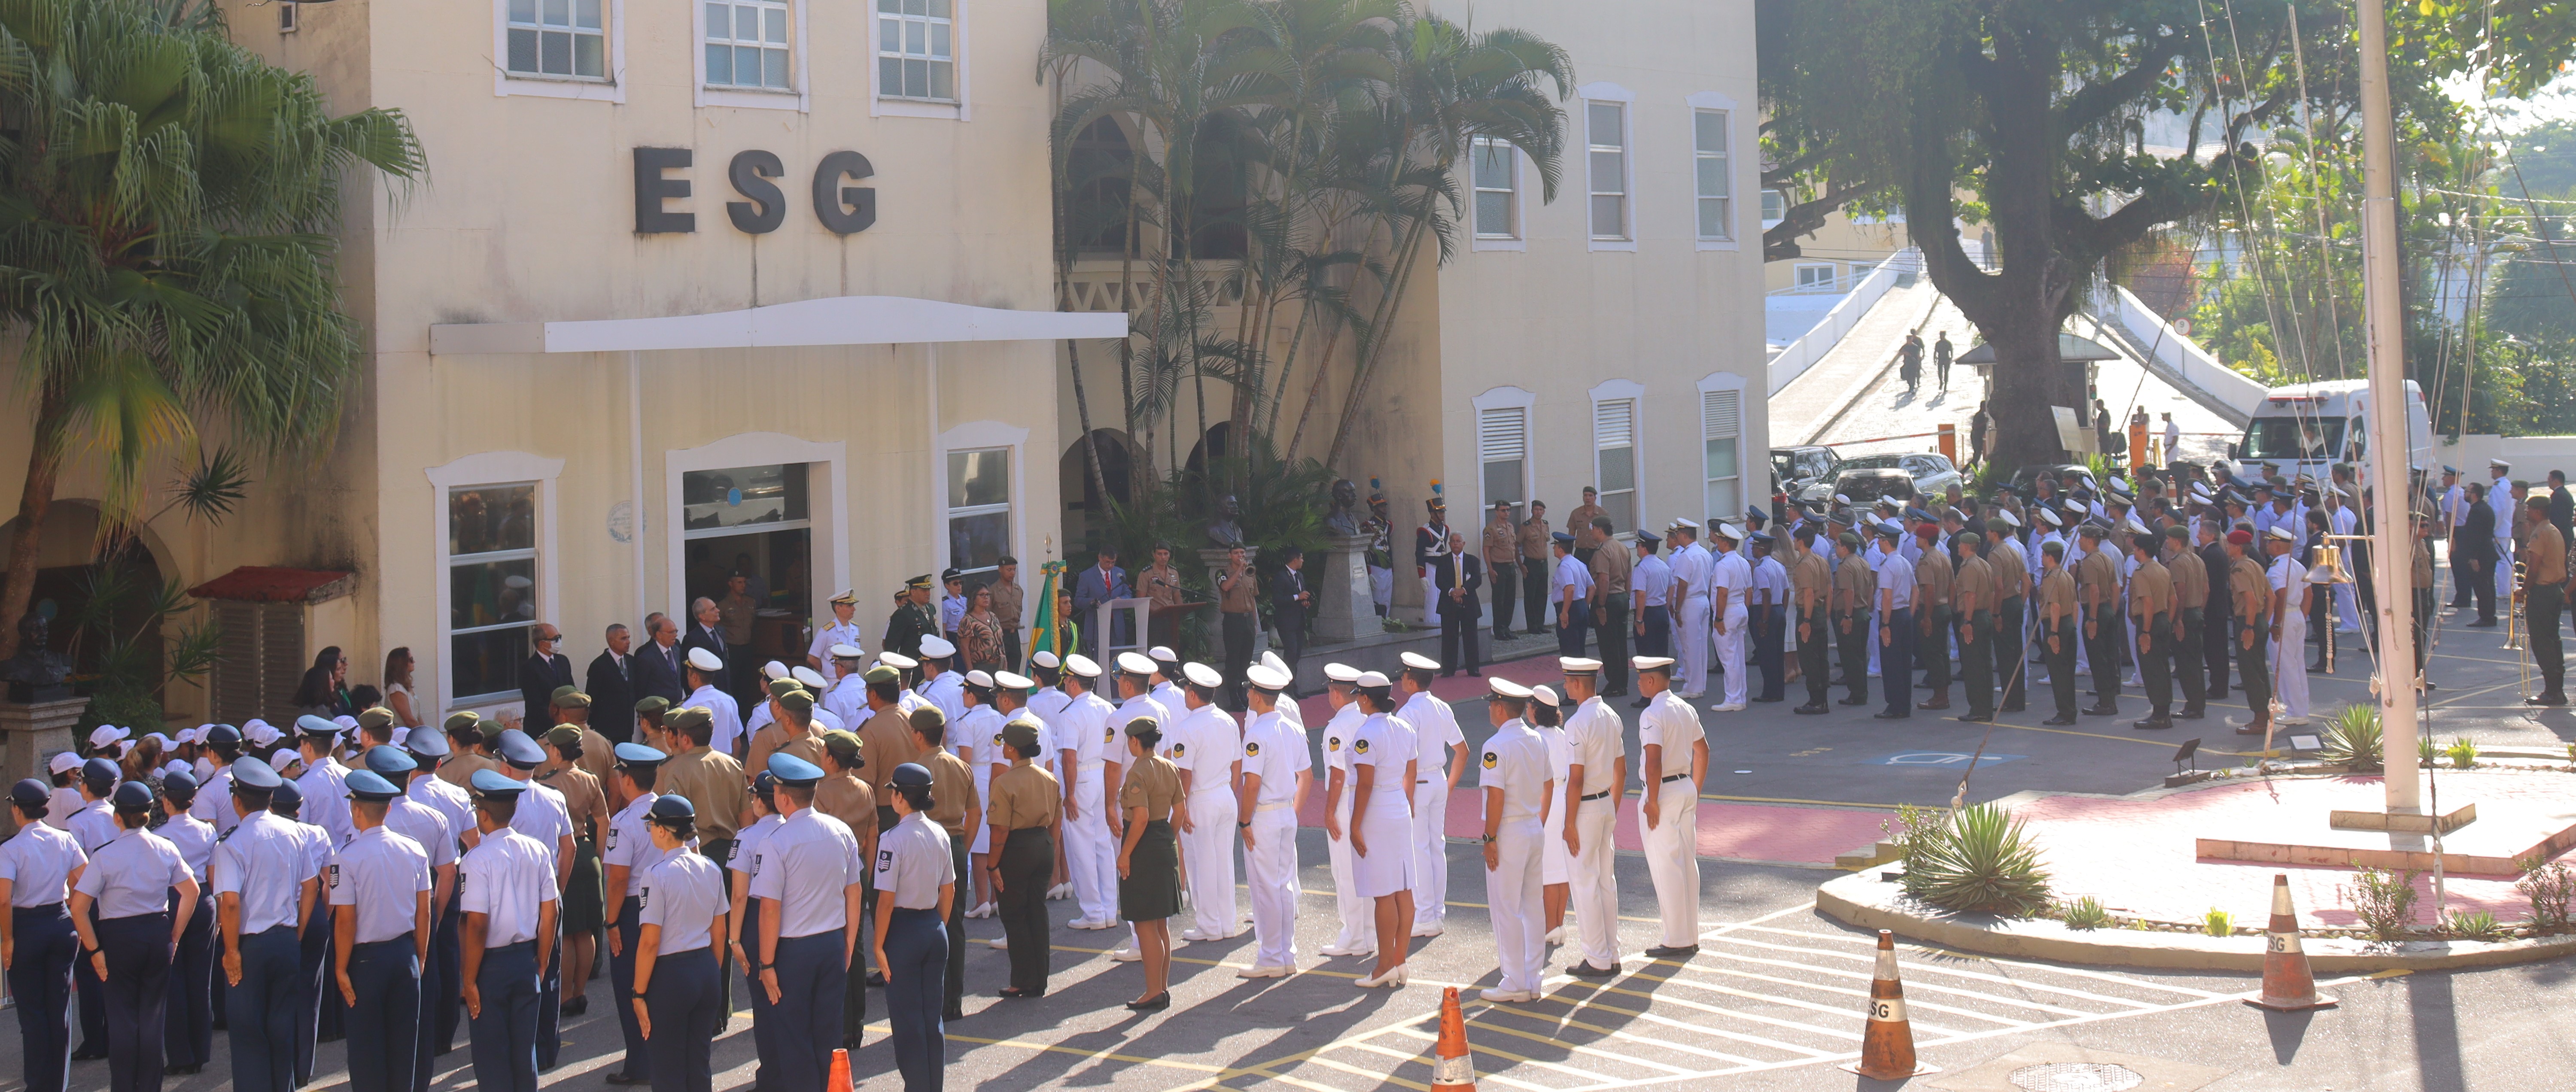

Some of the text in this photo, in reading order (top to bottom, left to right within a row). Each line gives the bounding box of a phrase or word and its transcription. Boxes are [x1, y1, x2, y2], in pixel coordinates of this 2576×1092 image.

[633, 147, 876, 234] ESG
[2268, 935, 2285, 952] SG
[1868, 1000, 1889, 1018] SG
